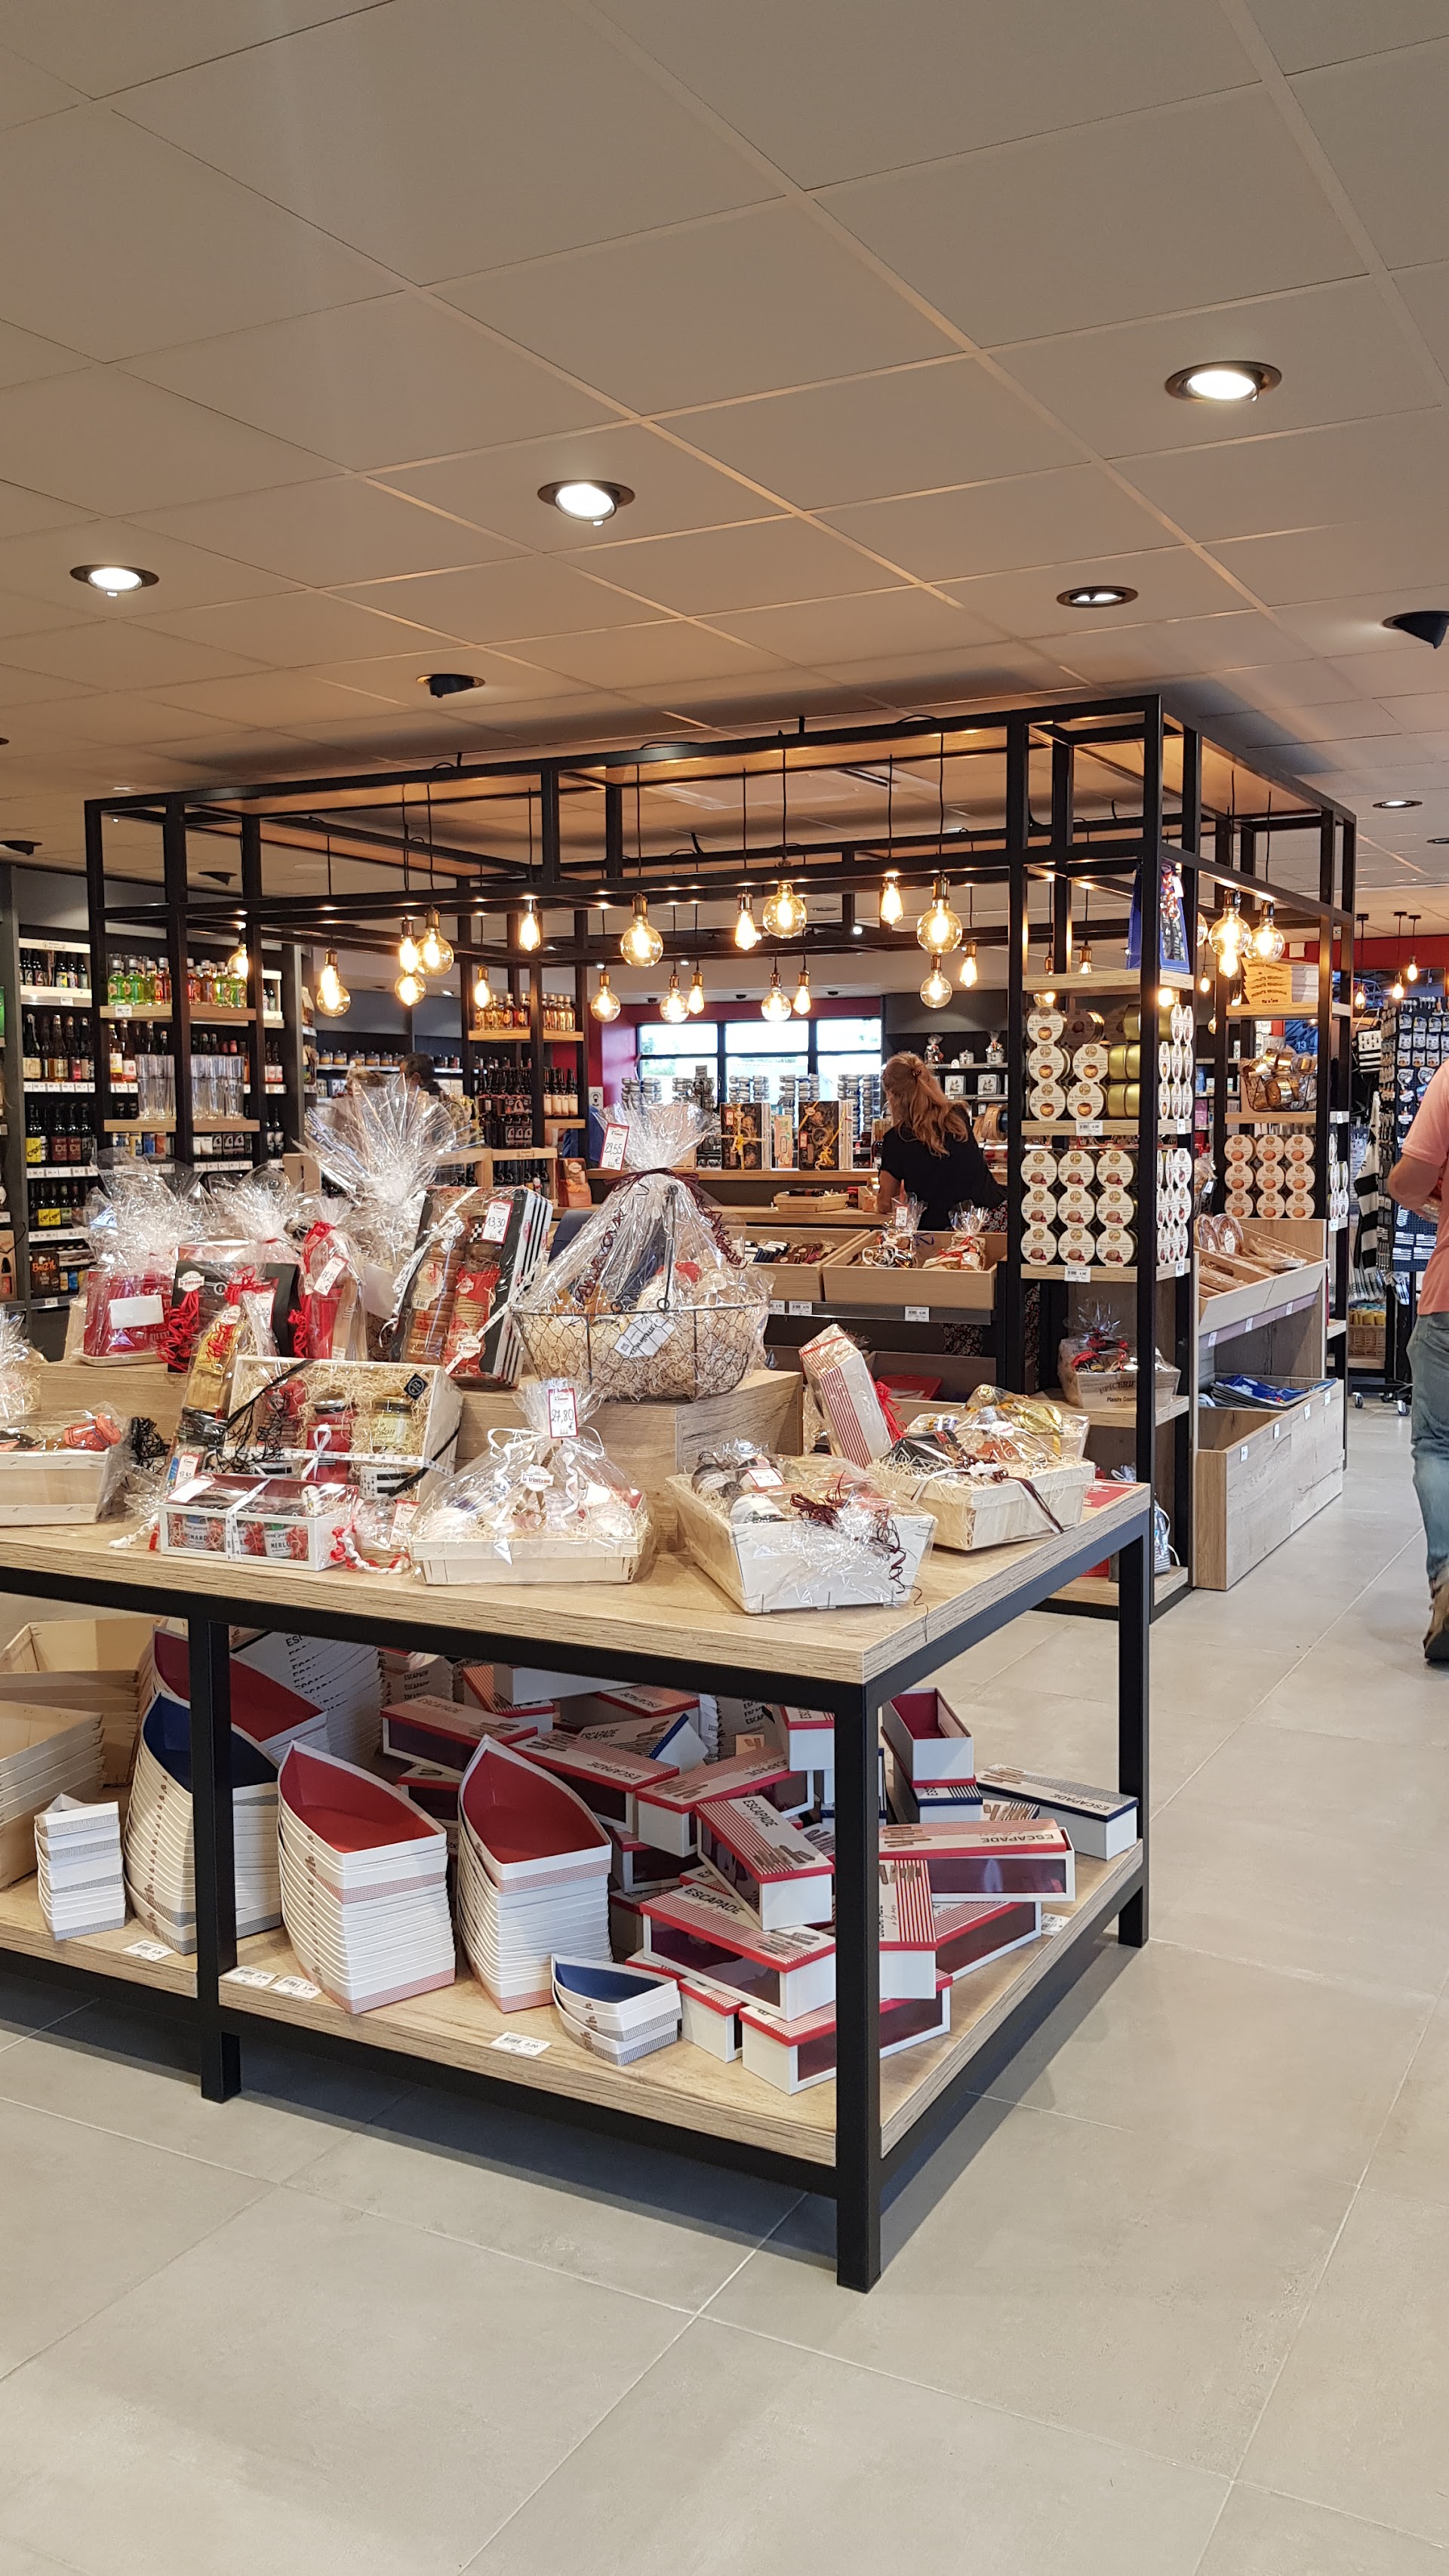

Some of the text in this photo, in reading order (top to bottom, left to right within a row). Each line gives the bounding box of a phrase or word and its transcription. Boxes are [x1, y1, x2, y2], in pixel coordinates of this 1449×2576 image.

[1298, 1041, 1307, 1050] 13
[486, 1216, 506, 1230] 13,30
[551, 1408, 574, 1423] 27,80
[417, 1698, 464, 1715] ESCAPADE
[586, 1761, 642, 1780] ESCAPADE
[1050, 1793, 1111, 1811] ESCAPADE
[743, 1799, 779, 1827] ESCAPADE
[980, 1833, 1054, 1843] ESCAPADE
[684, 1888, 746, 1915] ESCAPADE
